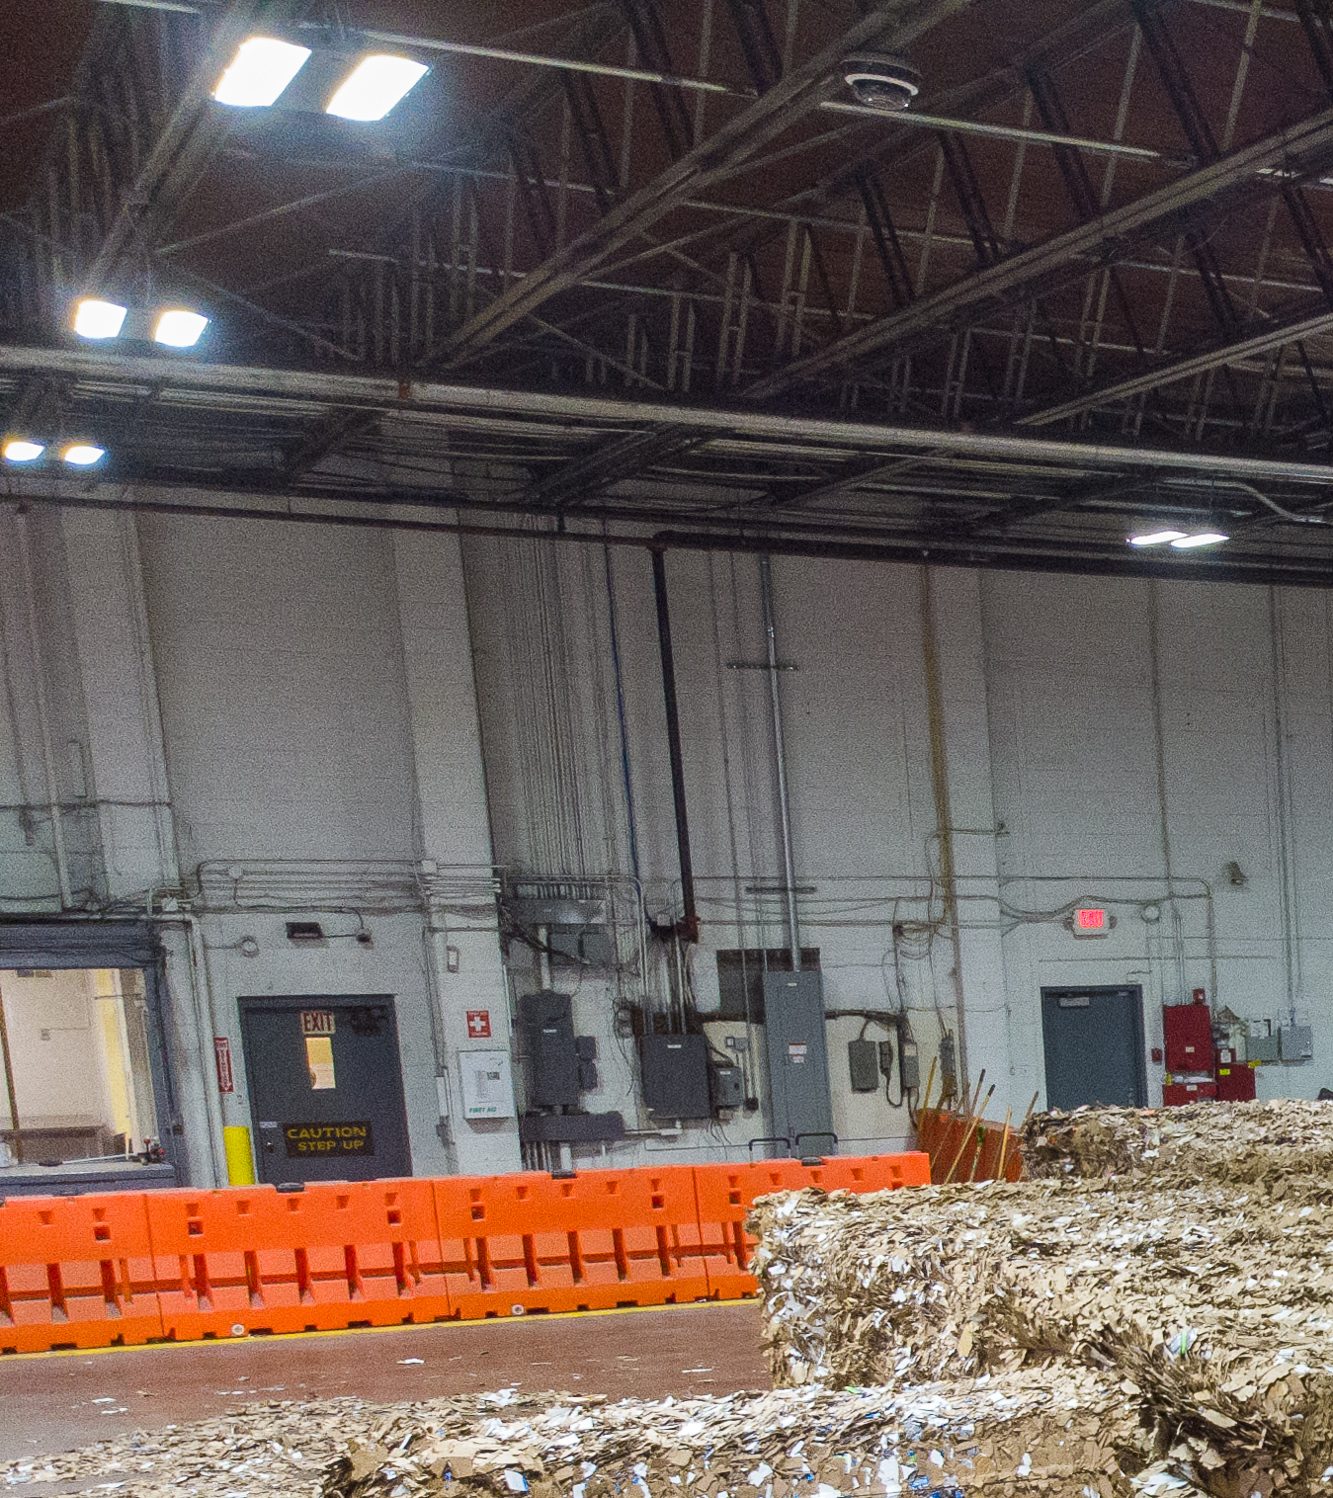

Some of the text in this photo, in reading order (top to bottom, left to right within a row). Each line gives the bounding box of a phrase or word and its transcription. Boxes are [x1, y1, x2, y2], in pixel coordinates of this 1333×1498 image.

[303, 1012, 332, 1032] EXIT
[287, 1127, 366, 1139] CAUTION
[297, 1140, 364, 1151] STEP UP
